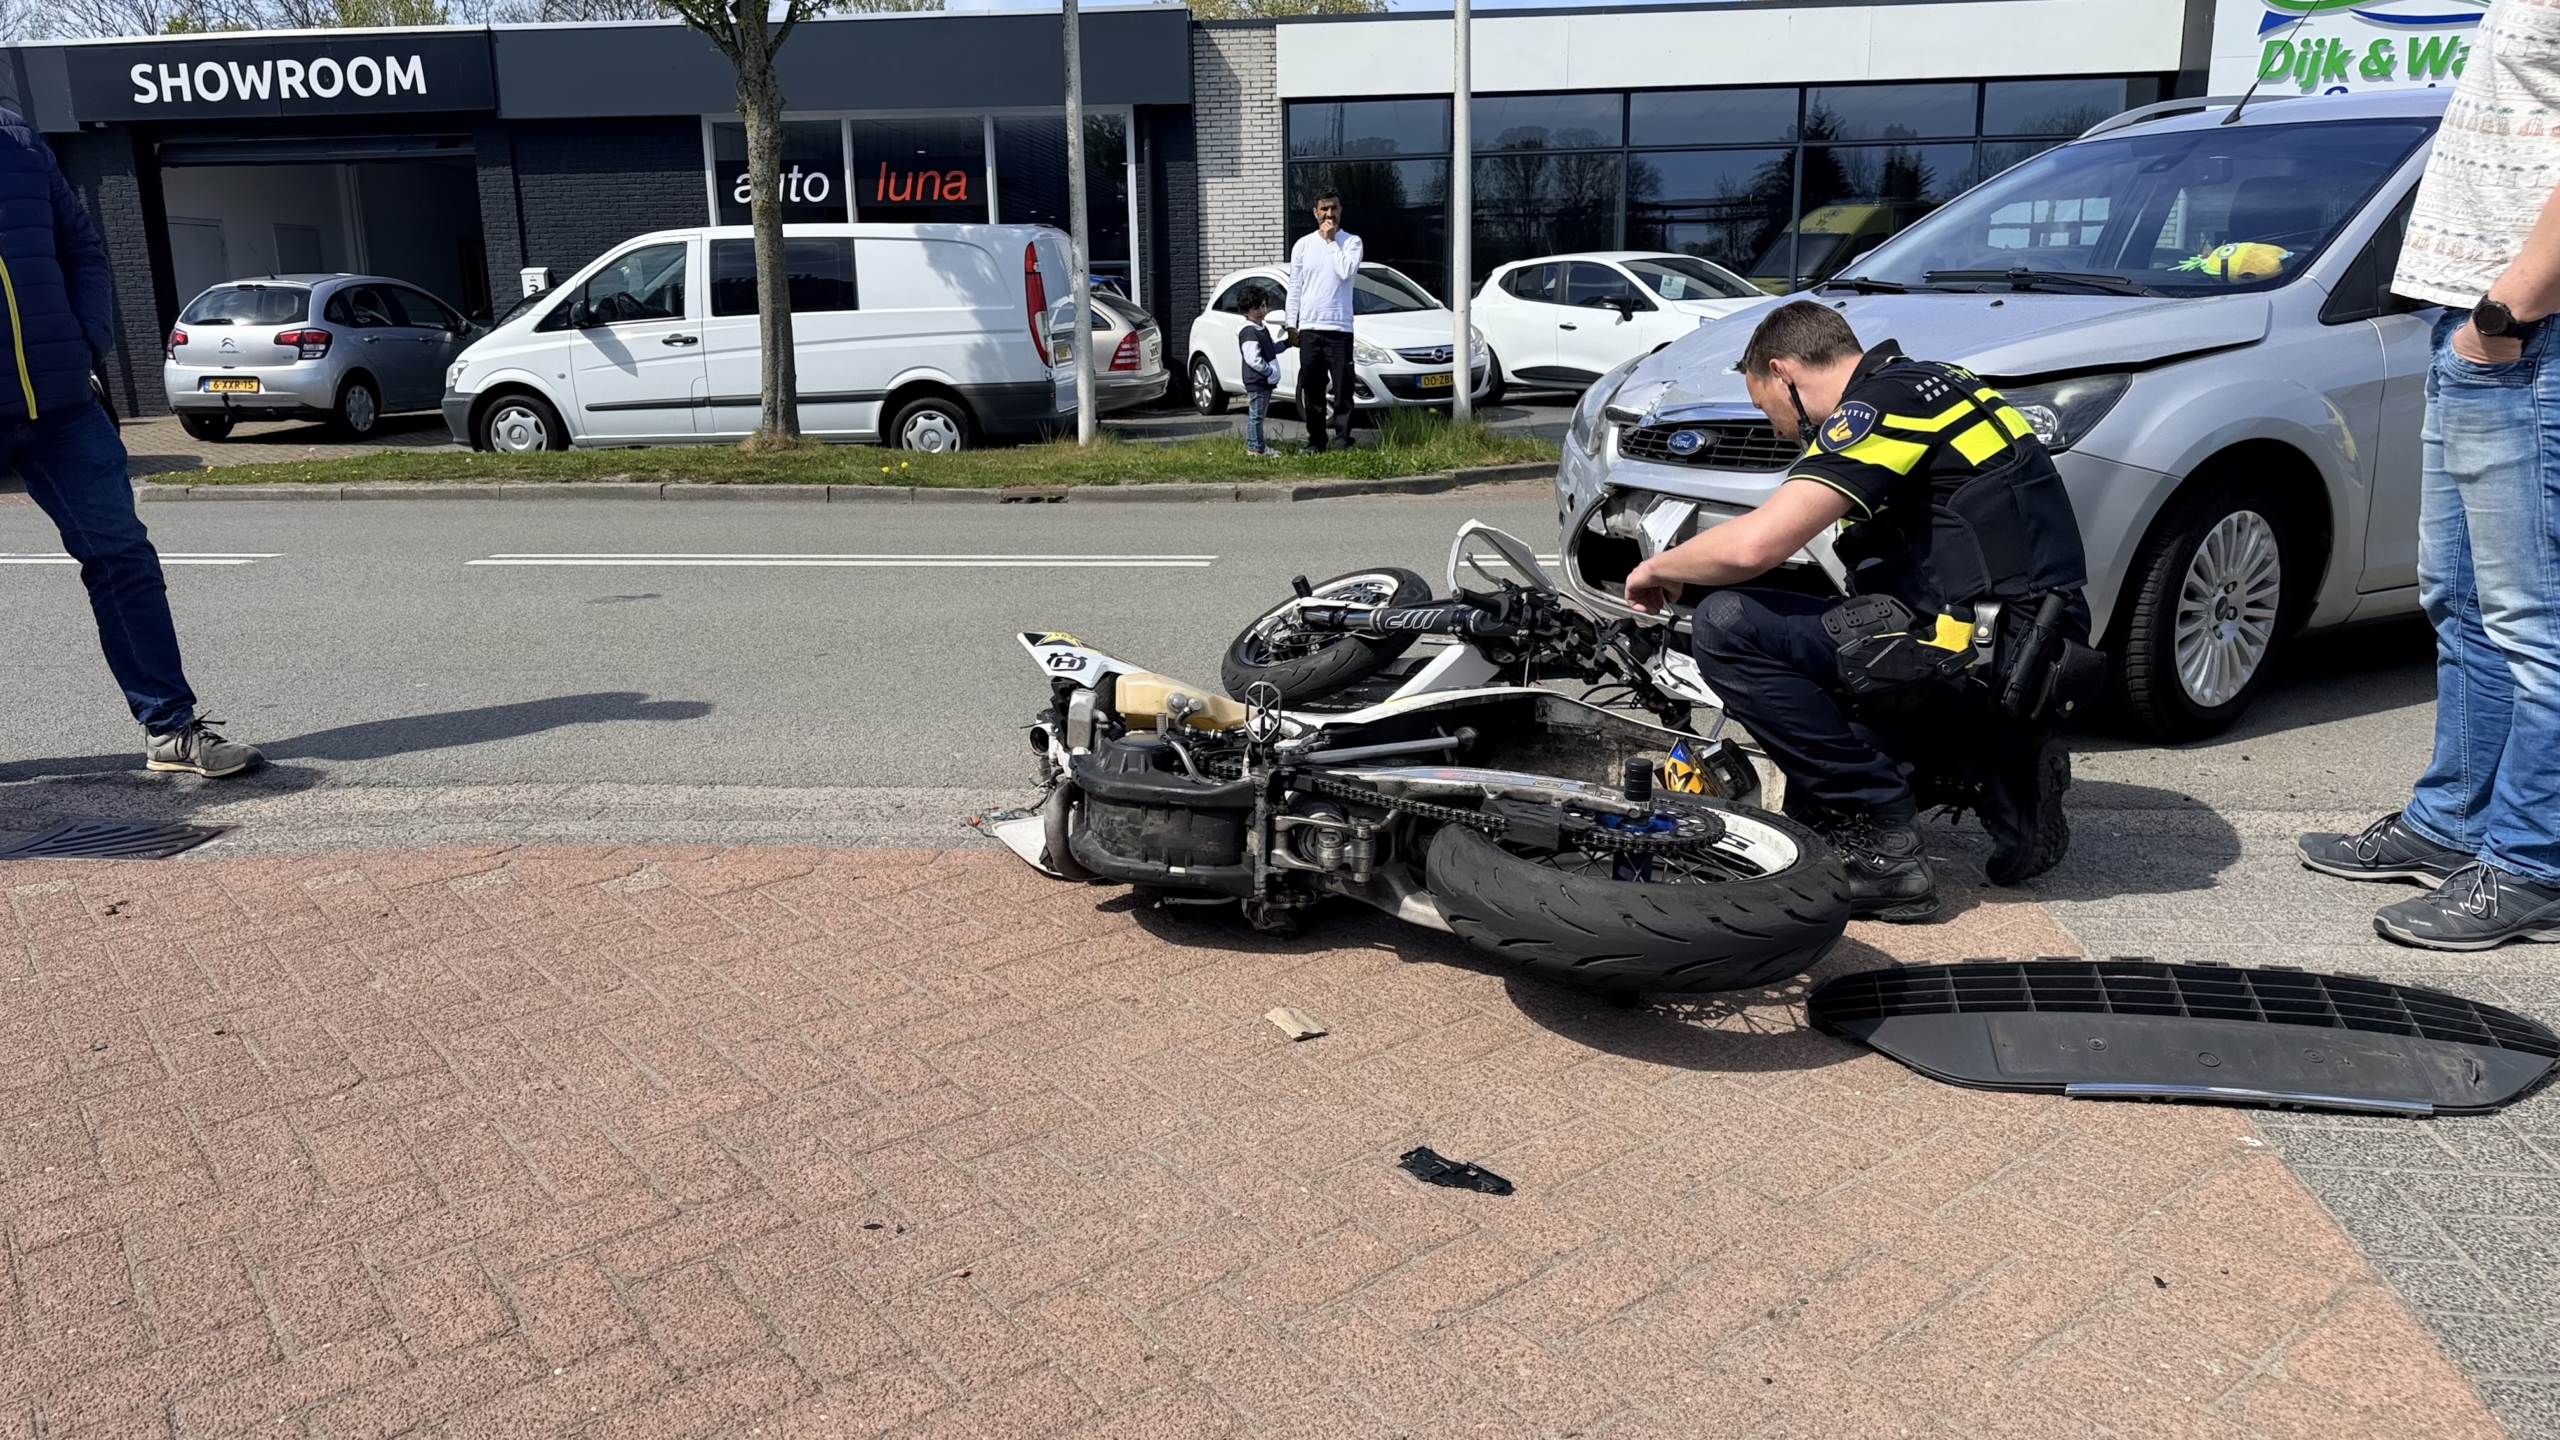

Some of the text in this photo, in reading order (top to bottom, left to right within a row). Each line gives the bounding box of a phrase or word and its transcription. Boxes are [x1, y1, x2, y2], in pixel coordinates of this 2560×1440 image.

[130, 55, 427, 104] SHOWROOM
[2257, 37, 2353, 88] Dijk
[2358, 38, 2396, 76] &
[733, 162, 967, 203] ato luna
[213, 380, 254, 390] 6-XXR-15
[1672, 434, 1693, 448] Ford
